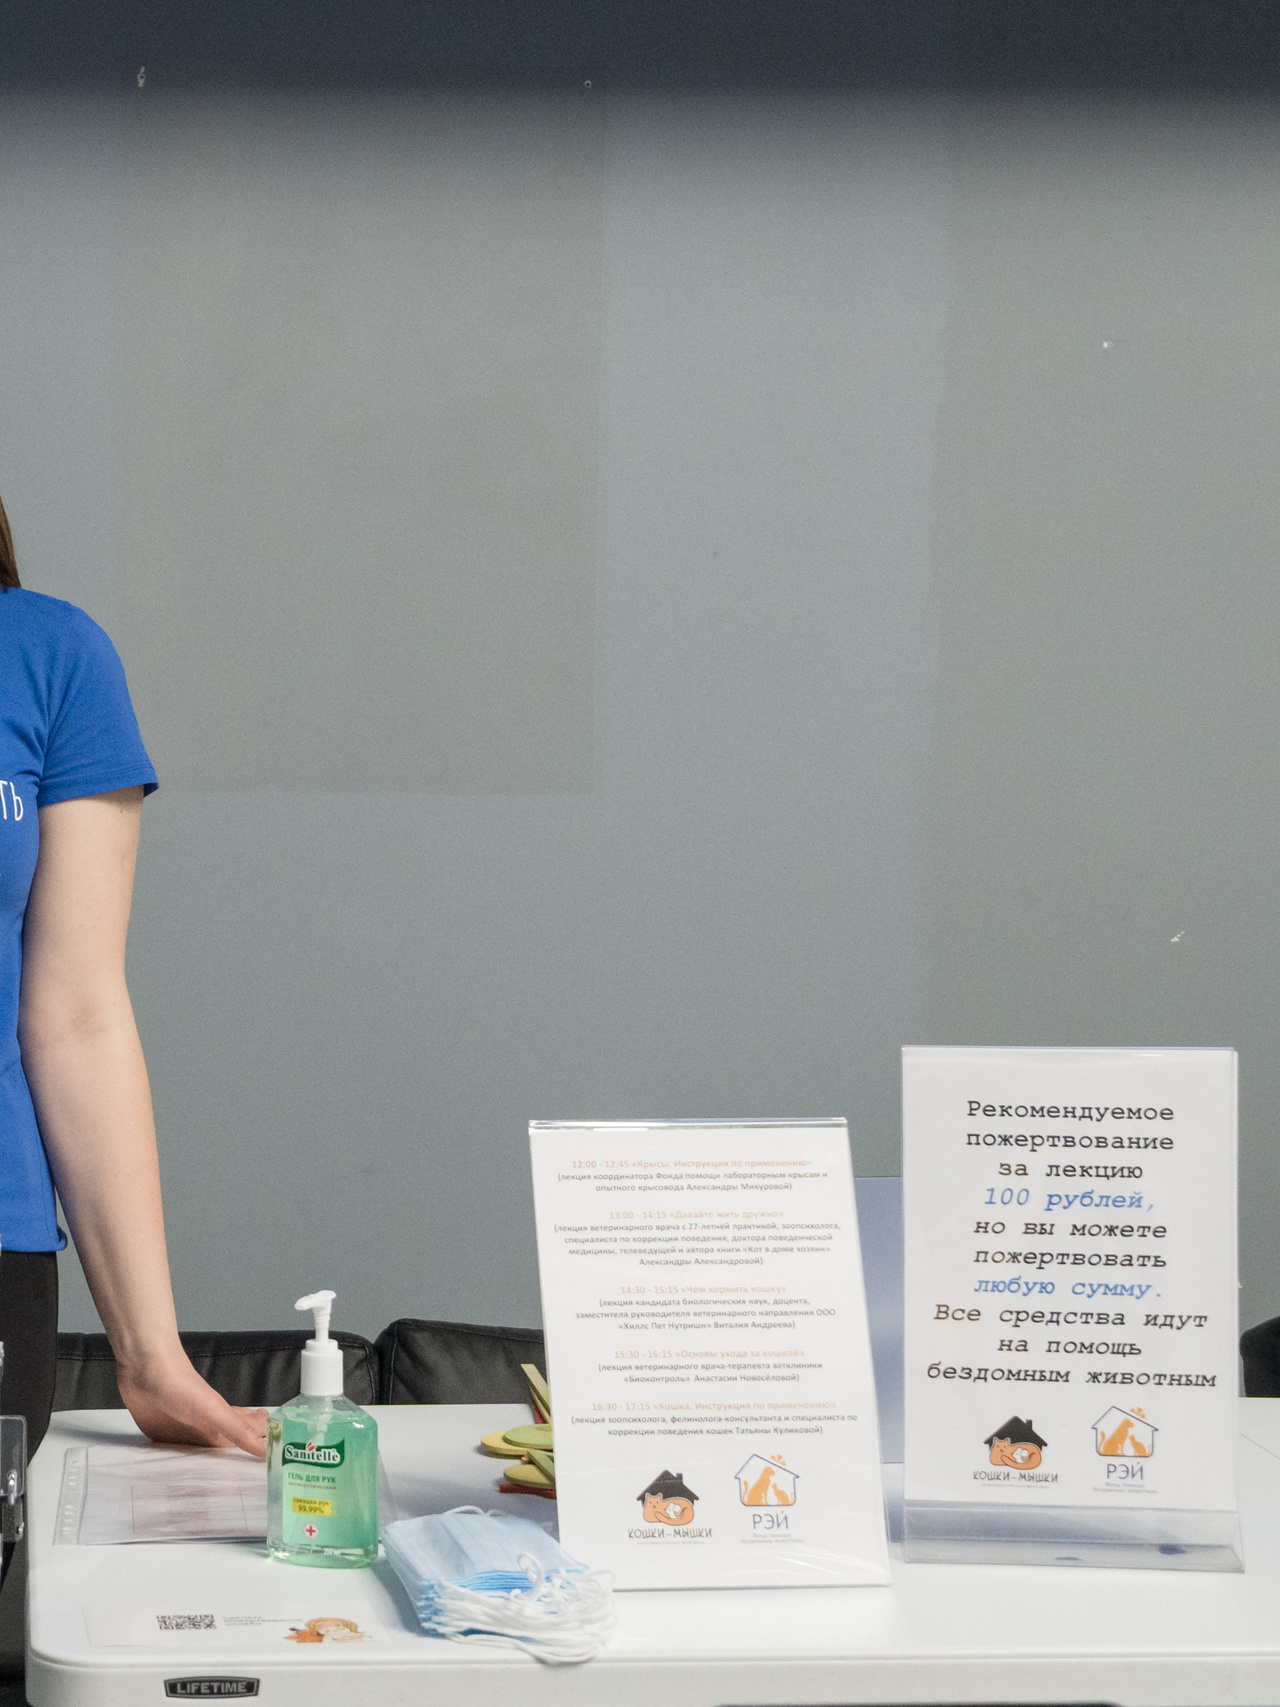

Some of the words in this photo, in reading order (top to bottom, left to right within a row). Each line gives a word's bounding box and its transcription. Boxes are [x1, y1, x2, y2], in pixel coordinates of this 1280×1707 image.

[967, 1100, 1173, 1123] Рекомендуемое
[966, 1133, 1173, 1154] пожертвование
[572, 1160, 597, 1168] 12:00
[605, 1159, 629, 1168] 12:45
[557, 1173, 591, 1181] (лекция
[593, 1173, 653, 1181] координатора
[655, 1172, 683, 1180] Фонда
[722, 1171, 786, 1180] лабораторным
[998, 1162, 1028, 1176] за
[1045, 1164, 1142, 1180] лекцию
[637, 1184, 684, 1192] крысовода
[686, 1183, 738, 1191] Александры
[984, 1187, 1029, 1205] 100
[1044, 1188, 1153, 1213] рублей,
[609, 1211, 634, 1219] 13:00
[642, 1210, 667, 1219] 14:15
[553, 1224, 588, 1233] (лекция
[589, 1224, 653, 1232] ветеринарного
[688, 1222, 730, 1230] 27-летней
[973, 1221, 1005, 1234] но
[1022, 1222, 1054, 1235] вы
[1069, 1223, 1166, 1238] можете
[564, 1236, 617, 1244] специалиста
[632, 1236, 679, 1244] коррекции
[767, 1233, 832, 1242] поведенческой
[619, 1246, 676, 1255] телеведущей
[638, 1258, 692, 1266] Александры
[973, 1250, 1166, 1271] пожертвовать
[621, 1286, 646, 1294] 14:30
[654, 1285, 678, 1294] 15:15
[973, 1275, 1055, 1297] любую
[1071, 1282, 1160, 1300] сумму.
[598, 1299, 633, 1307] (лекция
[635, 1299, 680, 1307] кандидата
[682, 1297, 746, 1305] биологических
[630, 1311, 690, 1319] руководителя
[692, 1310, 756, 1318] ветеринарного
[815, 1308, 836, 1316] ООО
[933, 1304, 981, 1321] Все
[999, 1309, 1125, 1330] средства
[1143, 1313, 1207, 1331] идут
[650, 1321, 666, 1329] Пет
[750, 1320, 795, 1329] Андреева)
[997, 1339, 1028, 1352] на
[1045, 1340, 1141, 1357] помощь
[614, 1350, 639, 1359] 15:30
[648, 1349, 673, 1358] 16:15
[598, 1363, 632, 1372] (лекция
[634, 1363, 698, 1371] ветеринарного
[693, 1374, 738, 1382] Анастасии
[927, 1361, 1070, 1384] бездомным
[1085, 1371, 1216, 1387] животным
[592, 1402, 617, 1411] 16:30
[625, 1402, 650, 1411] 17:15
[571, 1416, 605, 1424] (лекция
[656, 1428, 703, 1436] поведения
[734, 1426, 771, 1434] Татьяны
[772, 1425, 823, 1435] Куликовой)
[285, 1445, 340, 1463] Sanitelle
[1106, 1461, 1143, 1480] РЭЙ
[288, 1472, 304, 1481] ГЕЛЬ
[305, 1474, 320, 1483] ДЛЯ
[322, 1476, 336, 1484] РУК
[752, 1510, 788, 1530] РЭЙ
[176, 1681, 247, 1694] LIFETIME
